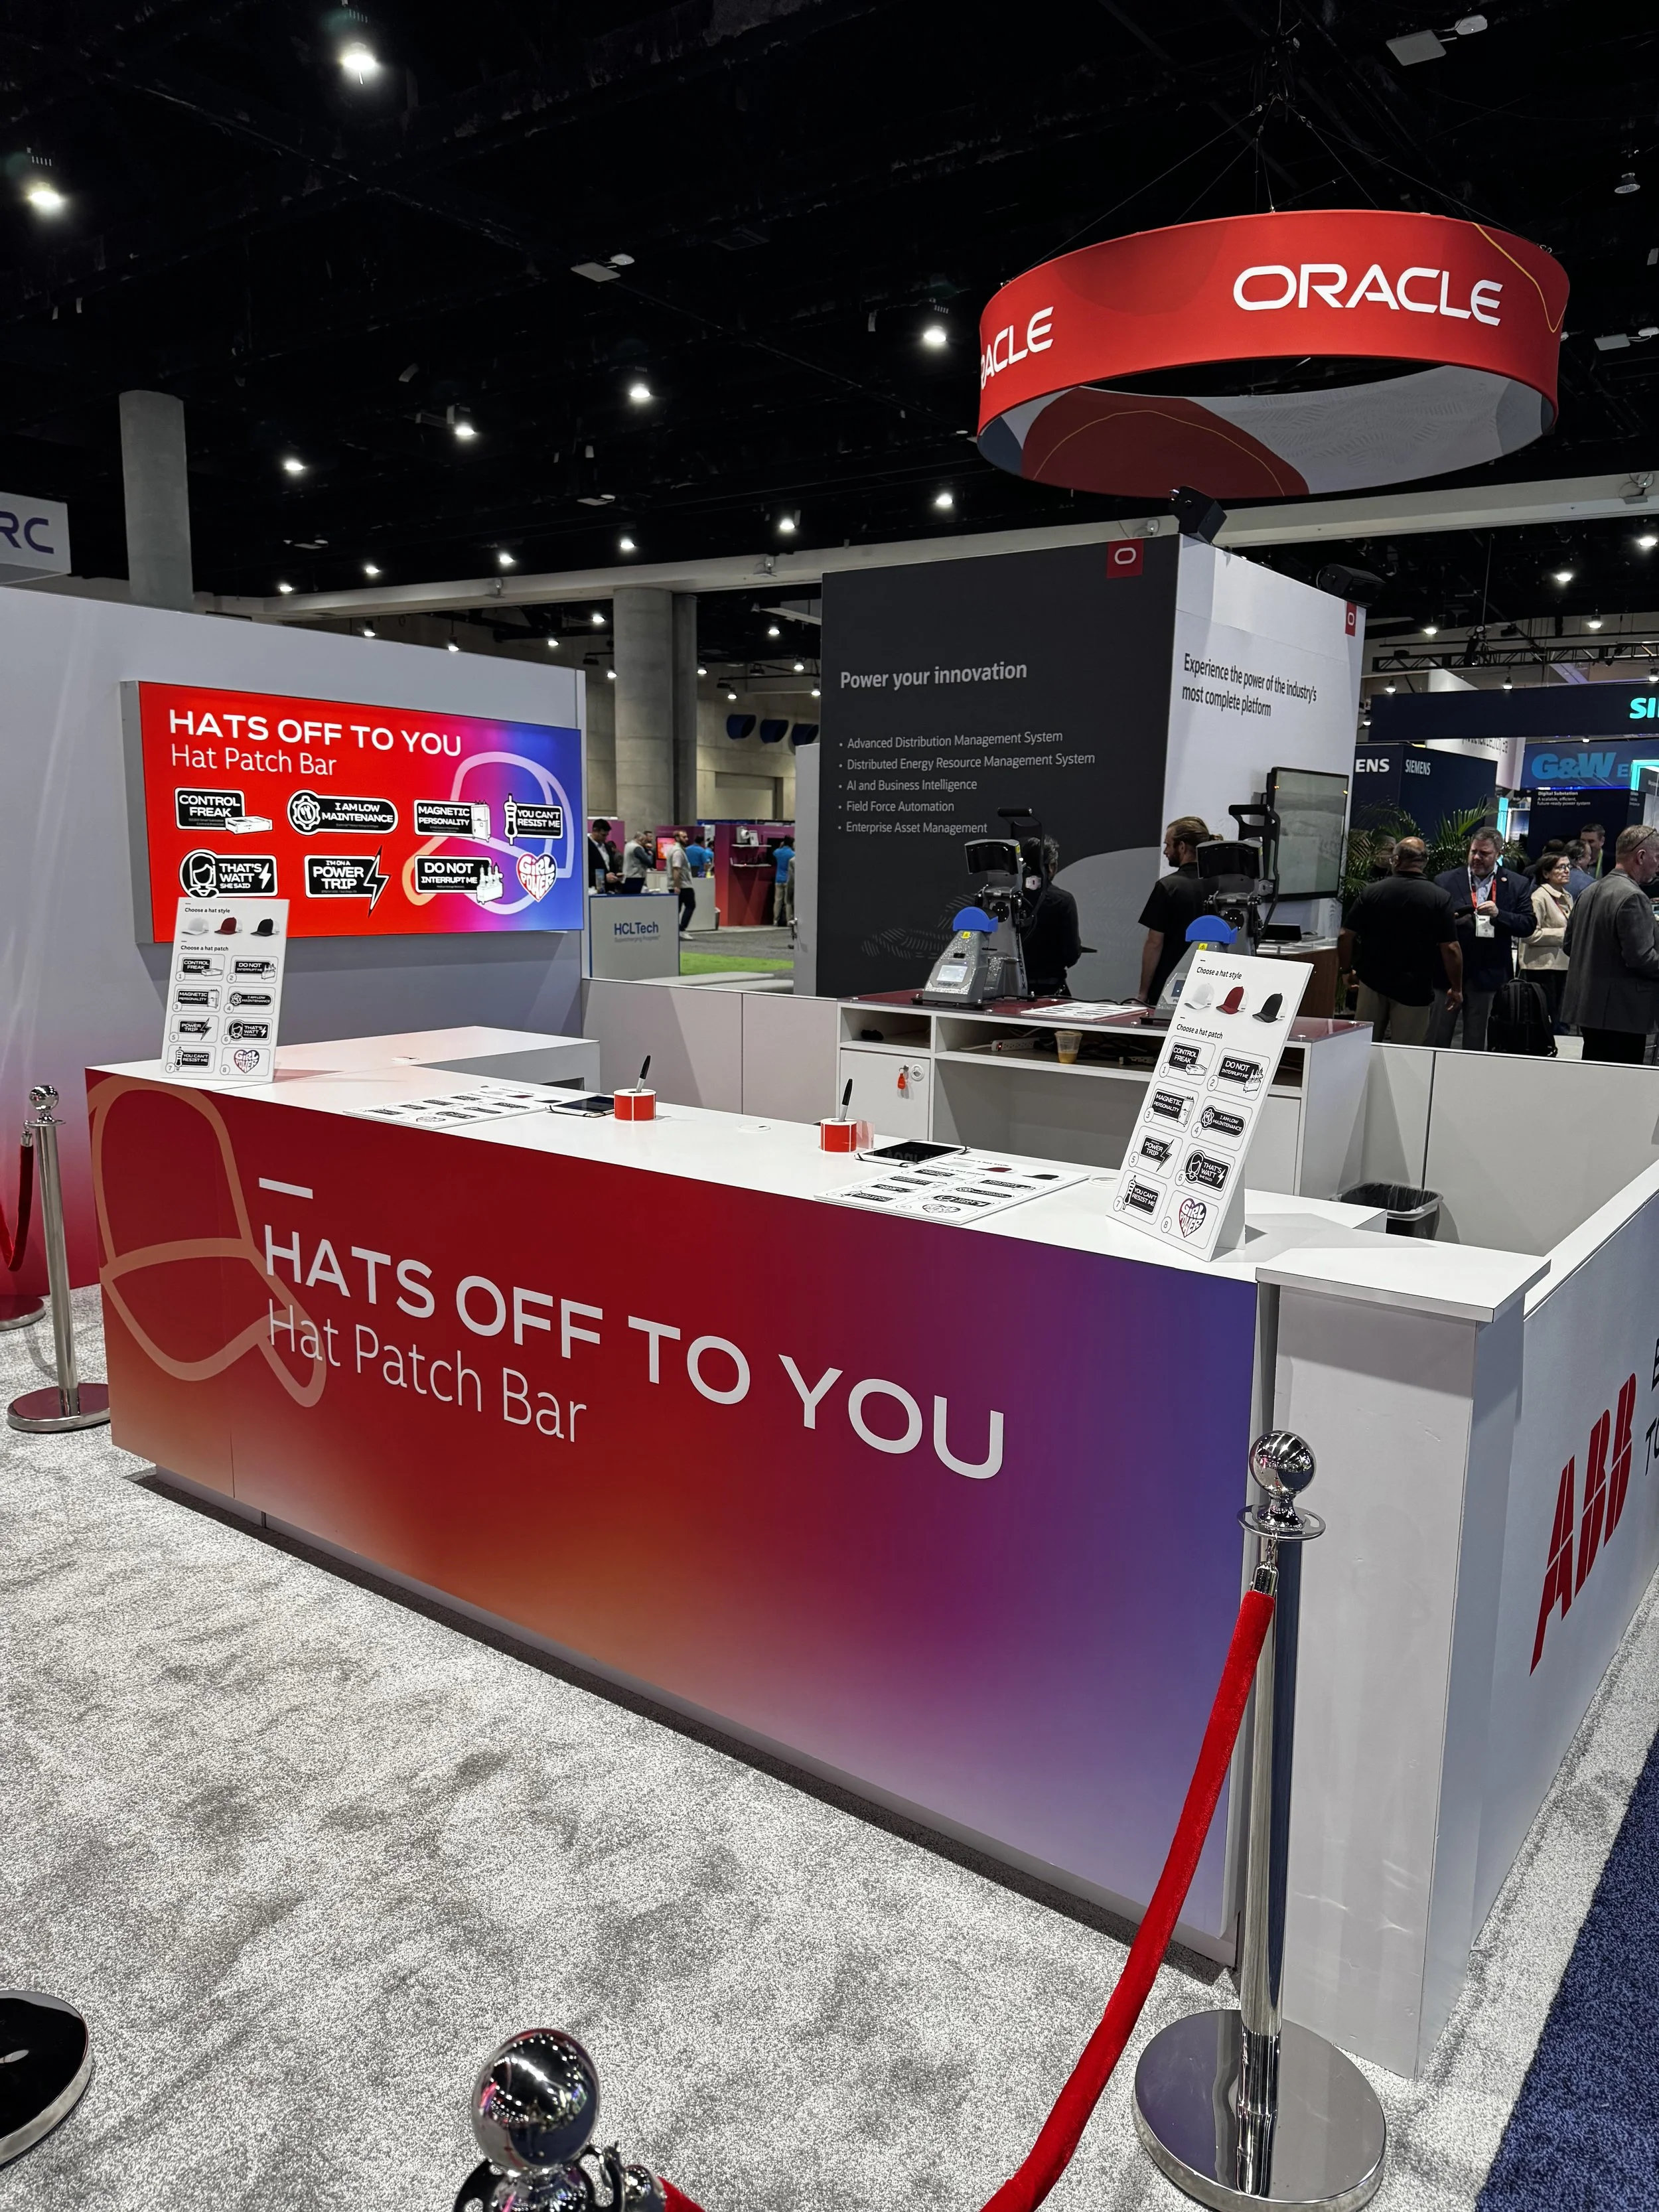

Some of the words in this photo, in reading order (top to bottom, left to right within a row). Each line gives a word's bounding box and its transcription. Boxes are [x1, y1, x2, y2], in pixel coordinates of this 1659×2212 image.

[1233, 263, 1504, 327] ORACLE
[840, 671, 889, 688] Power
[893, 670, 930, 691] your
[934, 661, 1027, 684] innovation
[1184, 652, 1228, 681] Experience
[1230, 665, 1242, 684] the
[1243, 673, 1265, 690] power
[1265, 675, 1274, 691] of
[1274, 677, 1285, 695] the
[1286, 679, 1317, 704] industry's
[1182, 685, 1204, 703] most
[1205, 690, 1240, 712] complete
[1241, 696, 1271, 717] platform
[1629, 698, 1659, 719] SI
[169, 709, 269, 741] HATS
[277, 719, 342, 745] OFF
[350, 725, 394, 751] TO
[401, 730, 461, 757] YOU
[847, 737, 893, 749] Advanced
[896, 735, 952, 748] Distribution
[954, 733, 1021, 747] Management
[1024, 731, 1063, 745] System
[171, 743, 218, 769] Hat
[225, 747, 292, 773] Patch
[300, 753, 337, 776] Bar
[847, 758, 898, 770] Distributed
[900, 758, 934, 771] Energy
[936, 757, 981, 769] Resource
[983, 755, 1052, 769] Management
[1055, 753, 1095, 768] System
[1405, 759, 1431, 775] SIEMENS
[1532, 752, 1617, 780] G&W
[847, 780, 857, 790] AI
[858, 780, 876, 790] and
[879, 779, 920, 790] Business
[922, 778, 977, 792] Intelligence
[179, 794, 240, 806] CONTROL
[847, 800, 868, 812] Field
[871, 800, 896, 812] Force
[898, 800, 954, 812] Automation
[189, 806, 232, 817] FREAK
[358, 804, 380, 812] LOW
[418, 806, 470, 817] MAGNETIC
[517, 809, 536, 818] YOU
[536, 810, 560, 819] CAN'T
[321, 812, 394, 823] MAINTENANCE
[418, 818, 470, 826] PERSONALITY
[846, 821, 893, 834] Enterprise
[895, 822, 920, 833] Asset
[923, 822, 987, 836] Management
[219, 863, 262, 873] THAT'S
[313, 866, 364, 877] POWER
[424, 862, 445, 873] DO
[446, 862, 474, 874] NOT
[219, 873, 255, 882] WATT
[321, 878, 357, 889] TRIP
[520, 874, 555, 899] POWER
[614, 921, 659, 935] HCLTech
[1196, 966, 1215, 976] Choose
[1229, 972, 1242, 980] style
[1177, 1023, 1194, 1033] Choose
[1198, 1027, 1208, 1036] hat
[1173, 1047, 1197, 1058] CONTROL
[1174, 1055, 1192, 1064] FREAK
[1236, 1063, 1250, 1072] NOT
[1156, 1094, 1183, 1106] MAGNETIC
[1153, 1101, 1180, 1112] PERSONALITY
[1212, 1119, 1243, 1131] MAINTENANCE
[1145, 1142, 1163, 1152] POWER
[1203, 1161, 1222, 1173] THAT'S
[1200, 1169, 1217, 1178] WATT
[1131, 1193, 1147, 1203] RESIST
[1143, 1191, 1157, 1201] CAN'T
[263, 1222, 436, 1319] HATS
[455, 1274, 603, 1359] OFF
[628, 1315, 751, 1406] TO
[778, 1354, 1005, 1481] YOU
[268, 1298, 342, 1369] Hat
[356, 1323, 483, 1414] Patch
[502, 1366, 587, 1443] Bar
[1529, 1372, 1636, 1677] ABB
